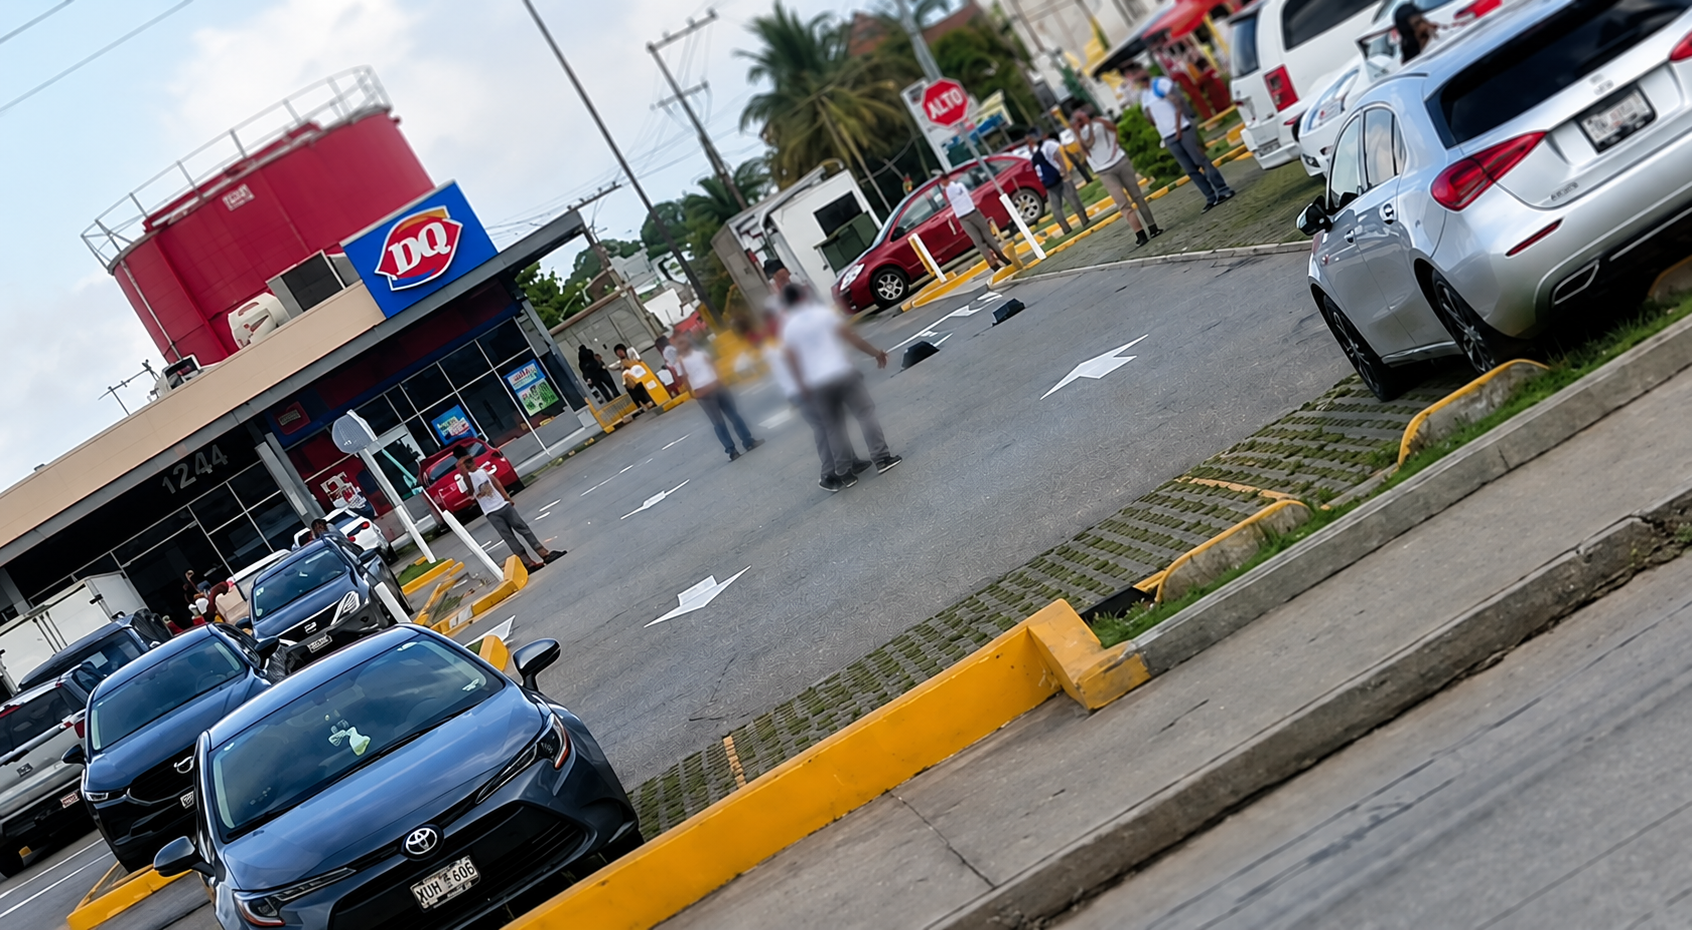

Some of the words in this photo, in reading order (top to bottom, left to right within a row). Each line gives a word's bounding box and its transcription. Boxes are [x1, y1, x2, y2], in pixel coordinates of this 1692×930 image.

[926, 87, 964, 119] ALTO
[388, 221, 452, 276] DQ
[161, 444, 229, 495] 1244
[416, 880, 443, 904] XUH
[452, 861, 475, 882] 606
